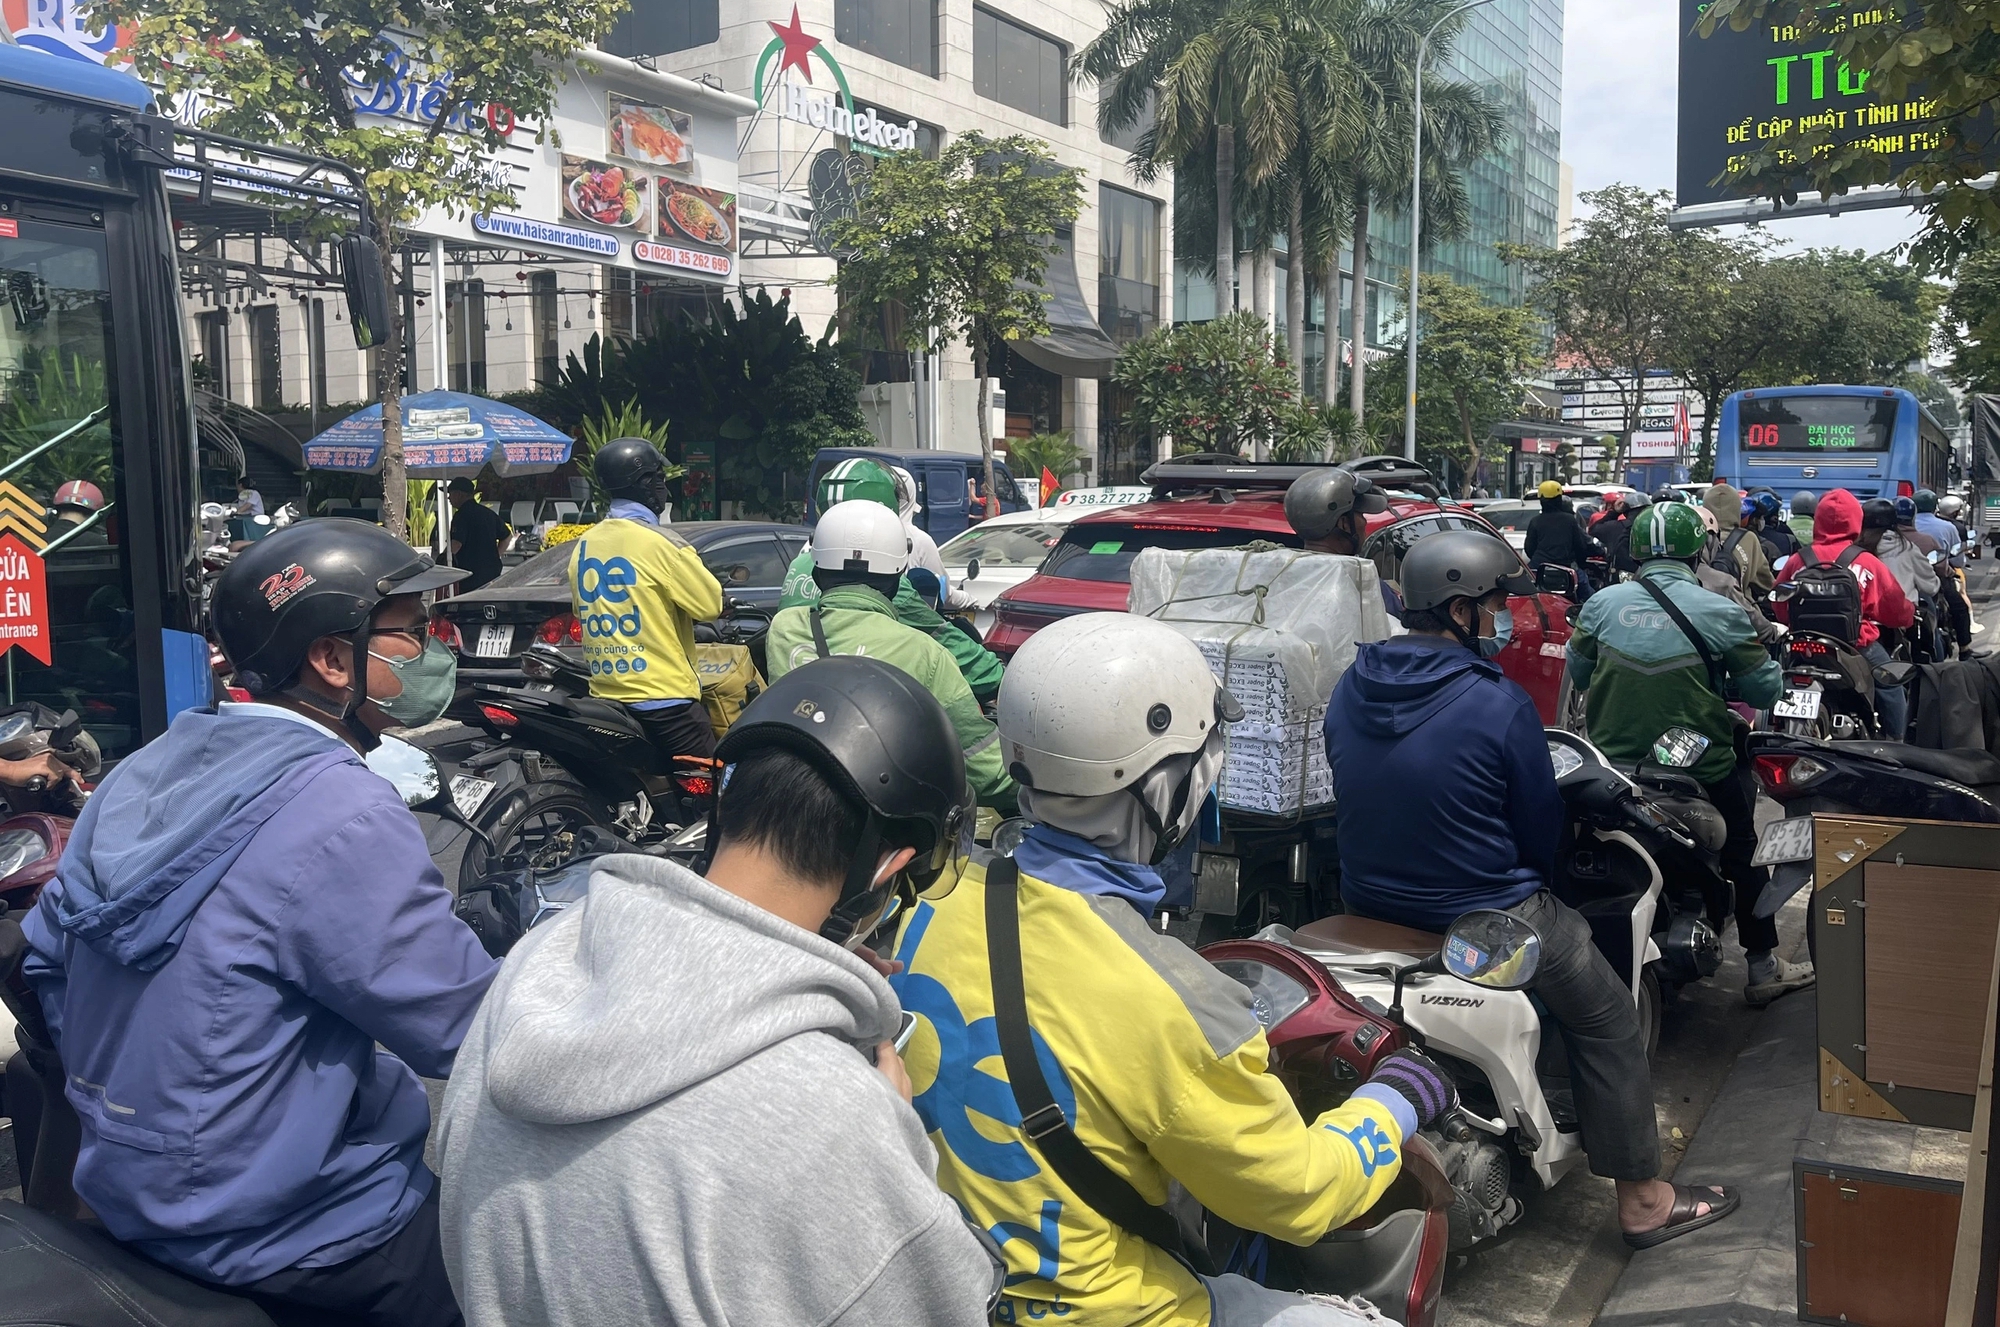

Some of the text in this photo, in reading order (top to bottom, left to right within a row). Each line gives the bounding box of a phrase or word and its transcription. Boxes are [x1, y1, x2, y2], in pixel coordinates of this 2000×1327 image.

[786, 82, 918, 150] Heineken
[1726, 116, 1753, 144] ĐỂ
[1854, 102, 1899, 126] TÌNH
[490, 218, 617, 254] www.haisanranbien.vn
[651, 244, 728, 272] (028) 35 262 699
[1748, 423, 1779, 447] 06
[1636, 440, 1676, 448] TOSHIBA
[1080, 493, 1116, 505] 38.27
[1118, 492, 1135, 503] 27
[578, 540, 637, 604] be
[0, 623, 38, 638] ntrance
[487, 625, 507, 640] 51H
[479, 641, 509, 657] 111.14
[603, 644, 628, 655] cũng
[631, 642, 645, 652] có
[1247, 679, 1265, 687] Super
[1246, 694, 1265, 702] Super
[1243, 744, 1262, 752] Super
[1243, 761, 1261, 769] Super
[1242, 777, 1261, 785] Super
[451, 779, 487, 799] 86-B6
[1241, 795, 1261, 803] Super
[1420, 994, 1485, 1008] VISION
[1324, 1117, 1398, 1179] be
